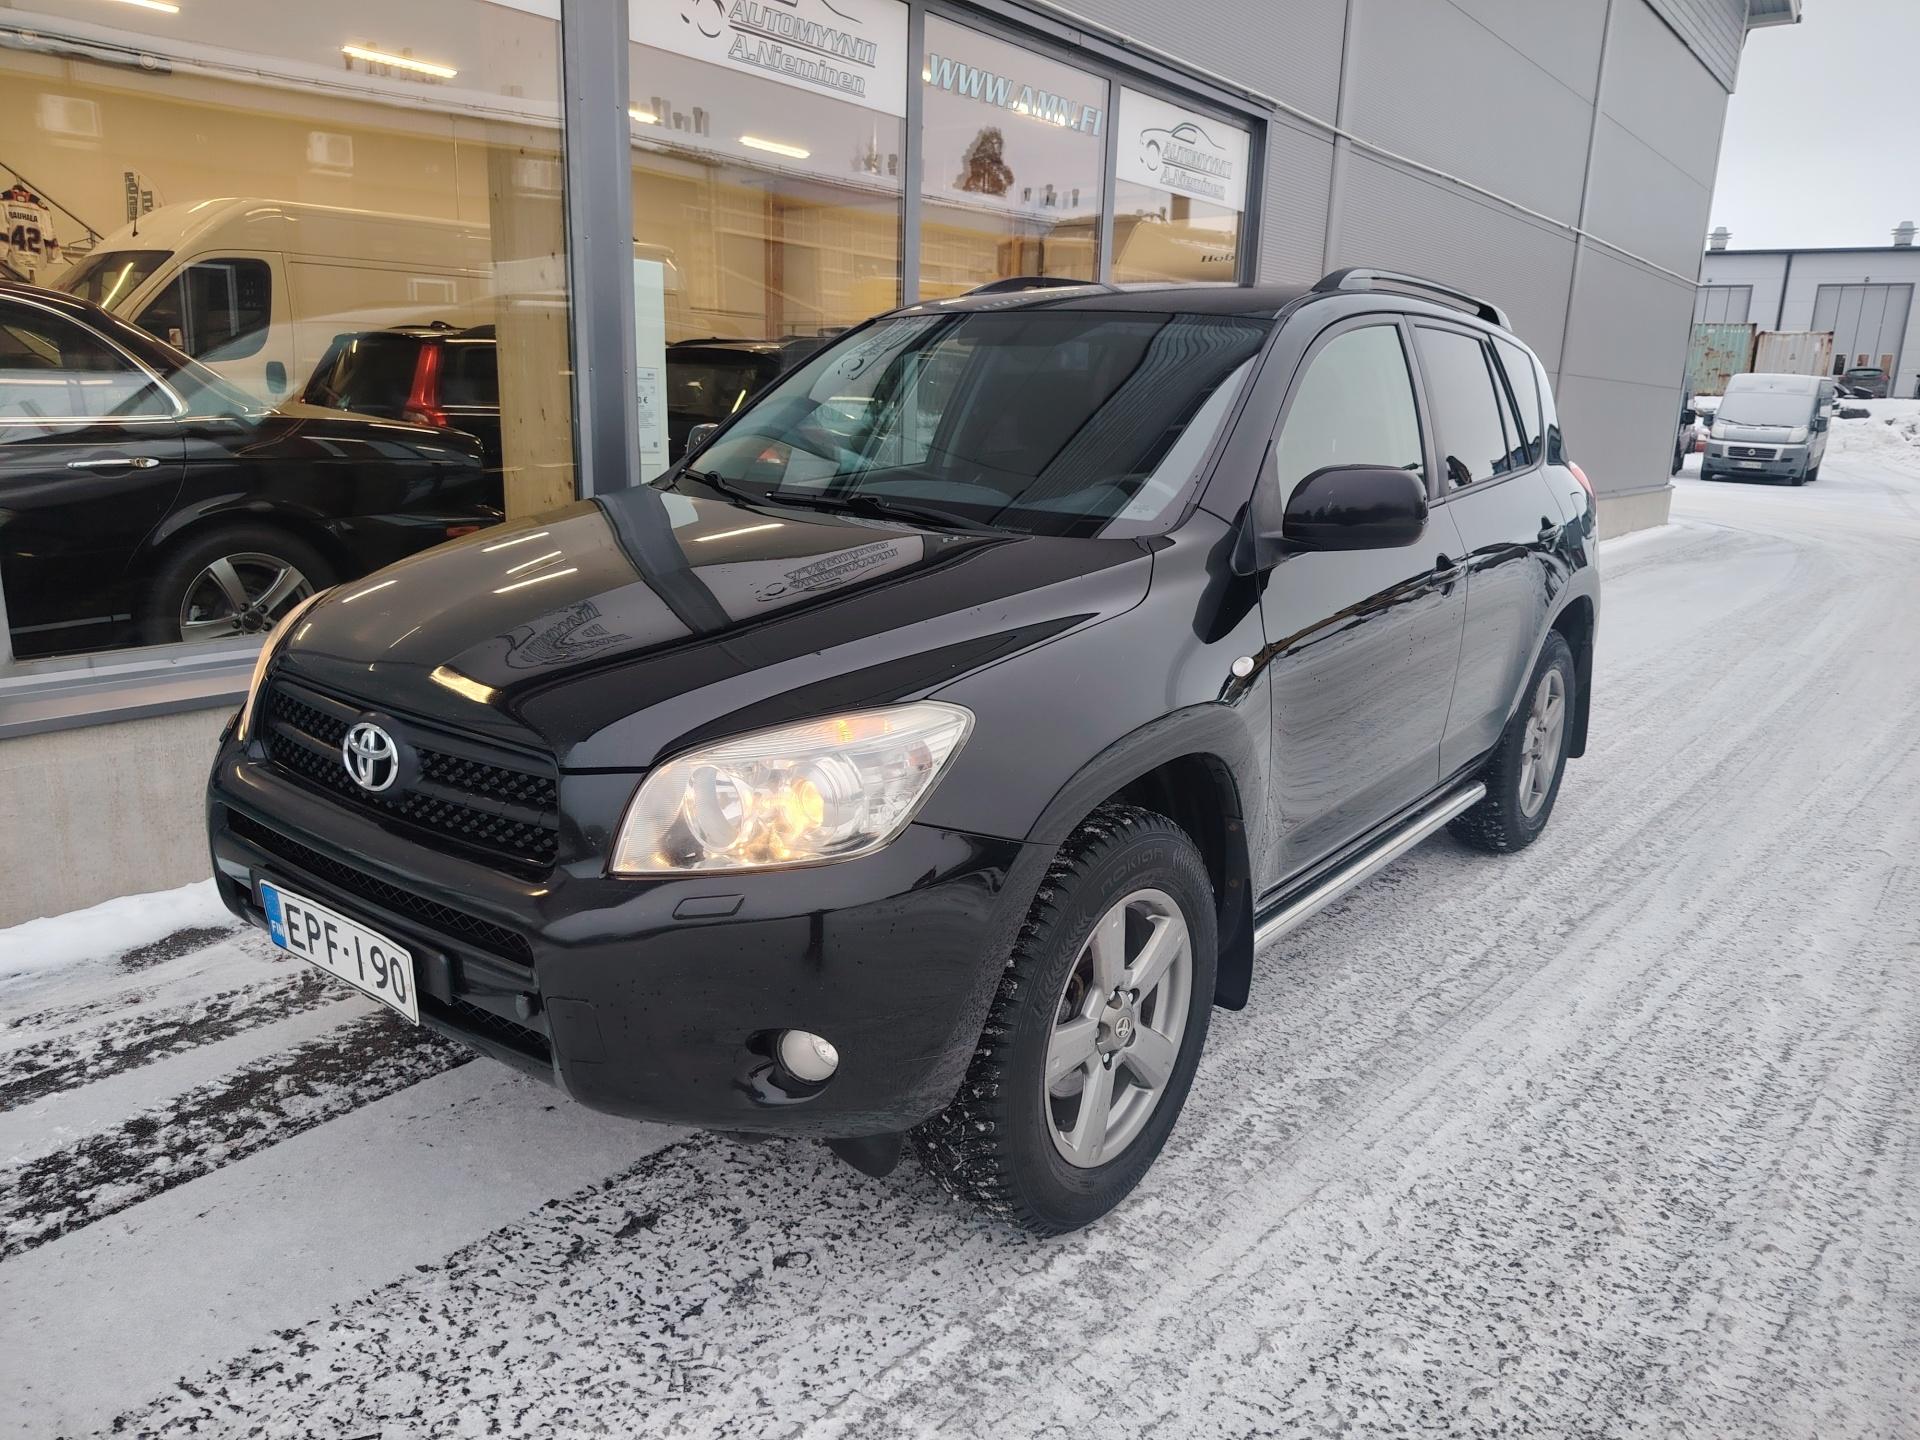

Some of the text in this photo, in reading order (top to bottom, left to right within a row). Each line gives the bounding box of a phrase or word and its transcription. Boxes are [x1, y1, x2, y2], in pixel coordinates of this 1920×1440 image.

[728, 0, 878, 65] AUTOMYYNTI
[929, 53, 1103, 137] WWW.AMN.FI
[11, 225, 42, 255] 42
[284, 901, 407, 1005] EPF-190
